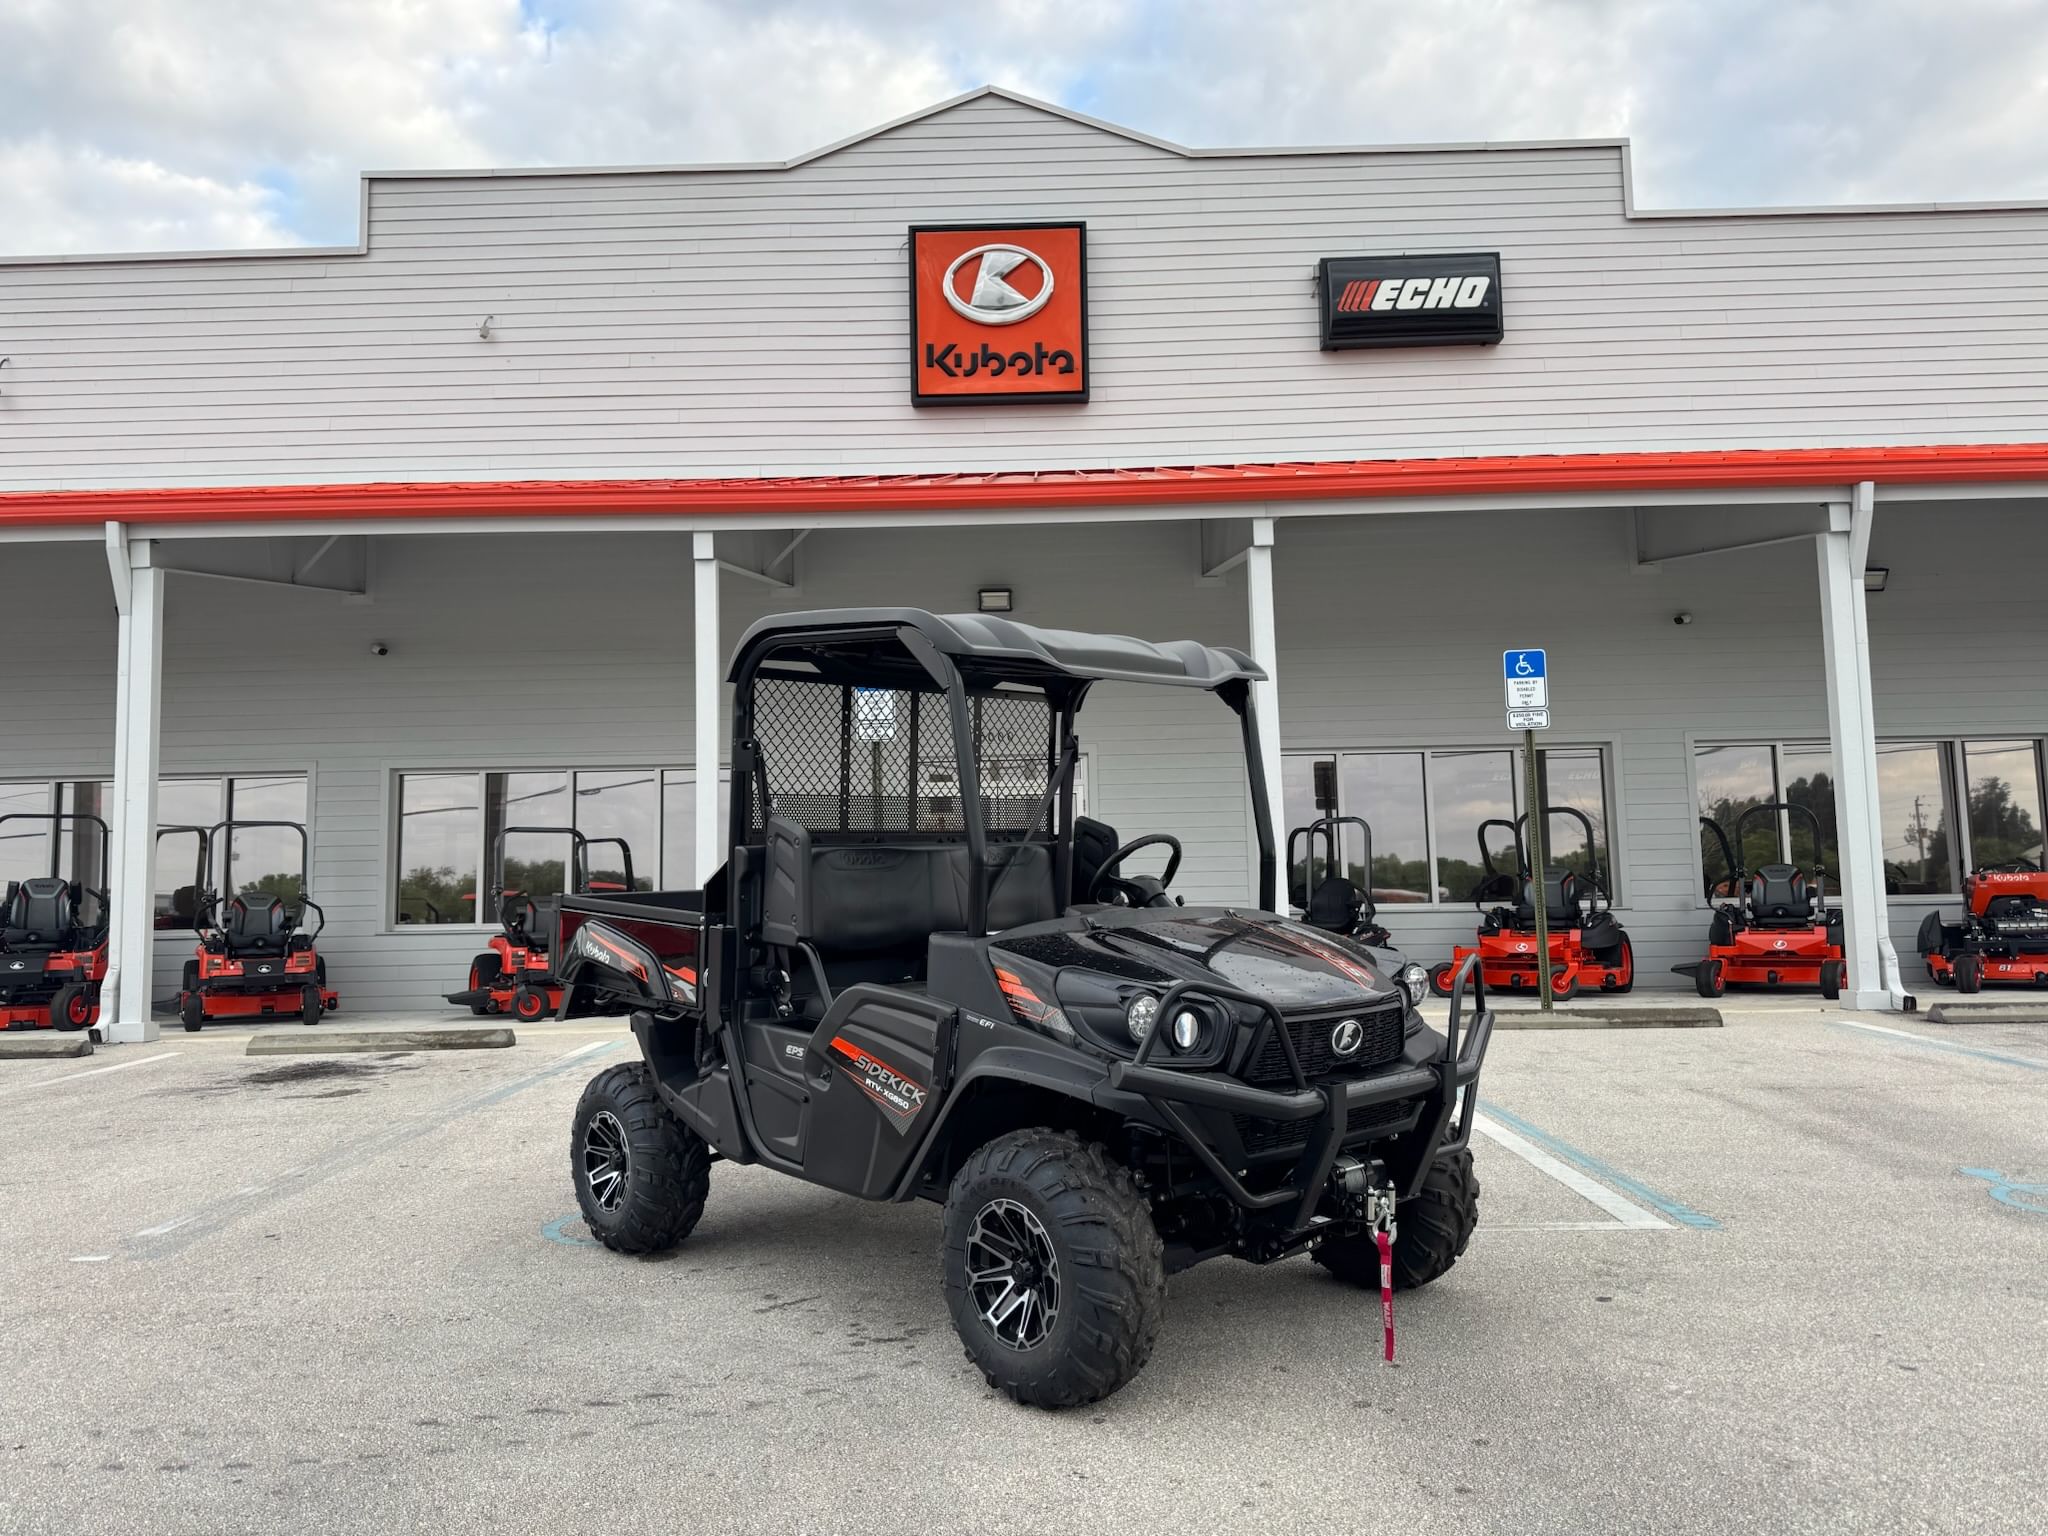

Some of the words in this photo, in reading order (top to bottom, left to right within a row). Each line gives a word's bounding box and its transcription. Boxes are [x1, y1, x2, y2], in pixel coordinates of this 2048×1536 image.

[1371, 276, 1490, 311] ECHO
[925, 342, 1075, 377] Kubota
[1993, 873, 2030, 882] Kubota
[586, 941, 610, 964] Kubota
[979, 1018, 996, 1030] EFI
[785, 1044, 805, 1057] EPS
[854, 1054, 926, 1105] SIDEKICK
[865, 1077, 910, 1110] RTV-XG850
